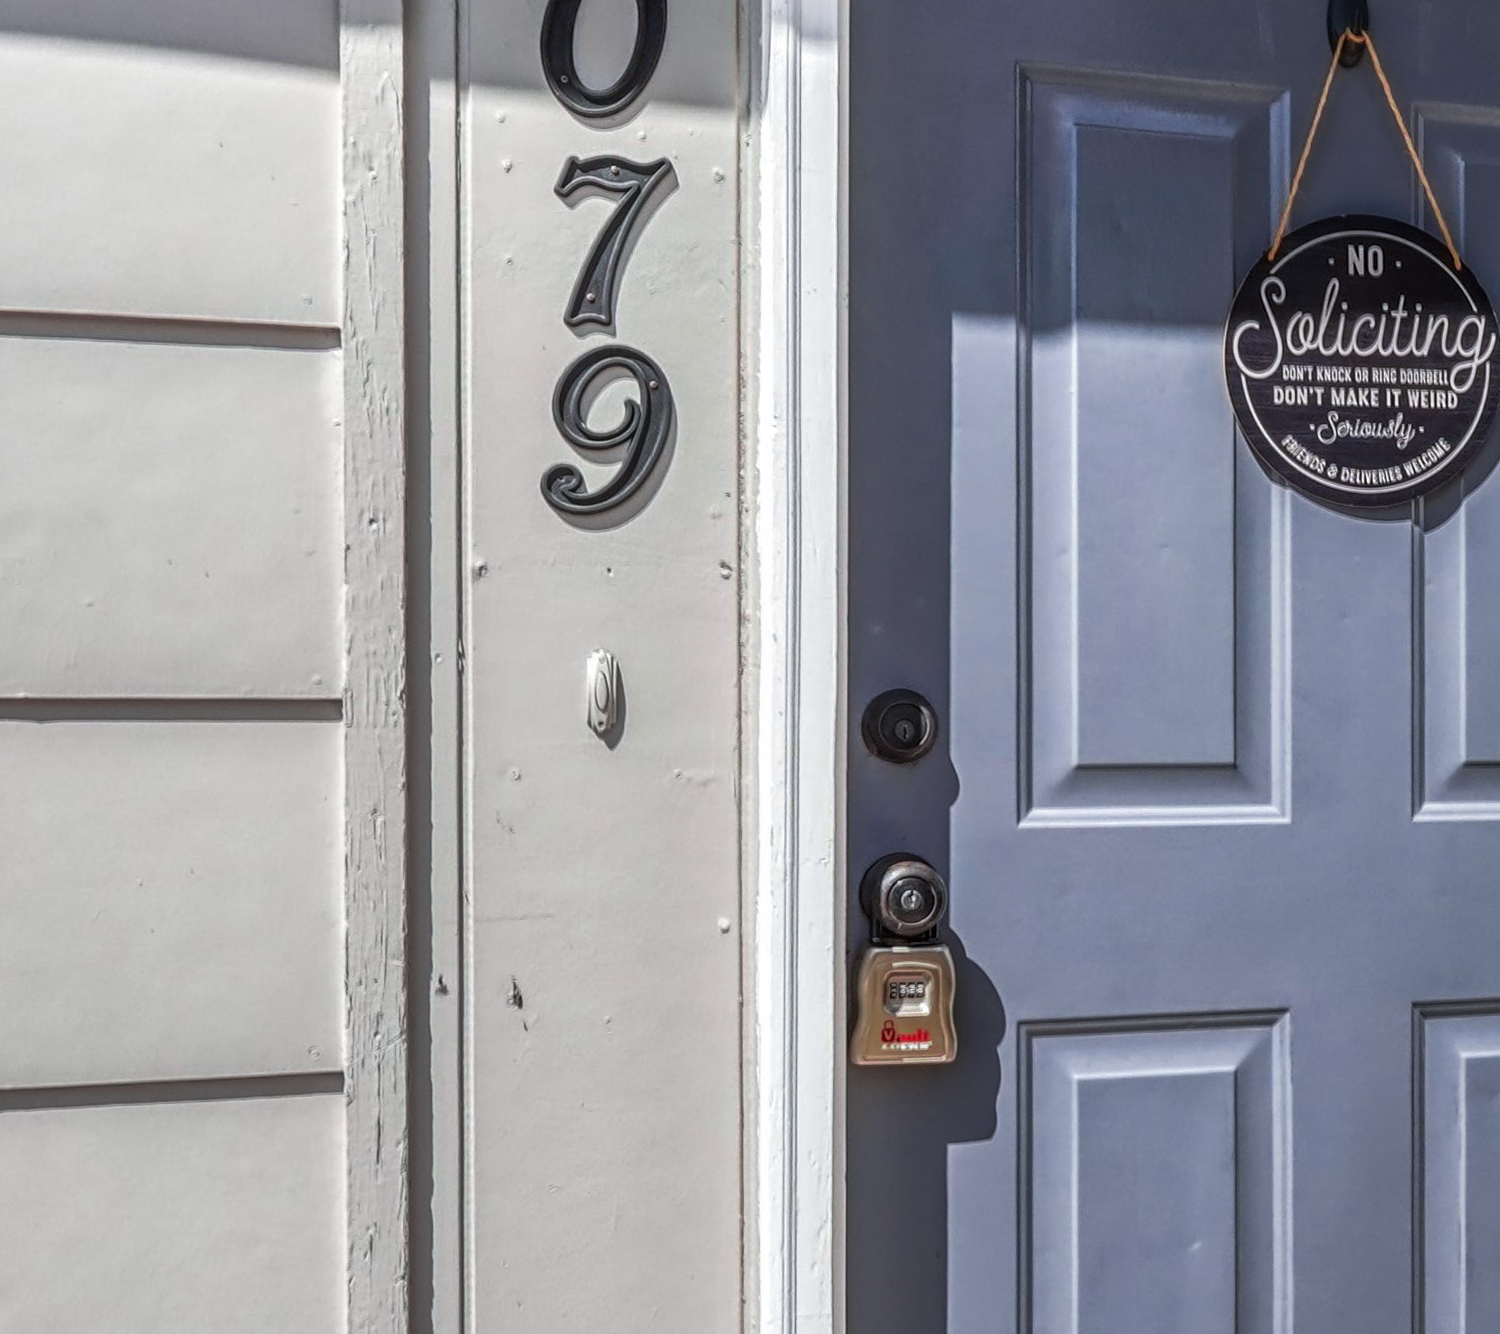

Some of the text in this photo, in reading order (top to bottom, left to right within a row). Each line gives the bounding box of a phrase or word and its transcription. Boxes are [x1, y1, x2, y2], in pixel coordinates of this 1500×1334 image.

[1348, 244, 1384, 277] NO
[1232, 276, 1497, 394] Soliciting
[1282, 365, 1449, 386] DON'T KNOCK OR RING DOORBELL
[1273, 385, 1459, 410] DON'T MAKE IT WEIRD
[1316, 410, 1416, 451] Seriously
[1281, 434, 1452, 486] FRIENDS & DELIVERIES WELCOME
